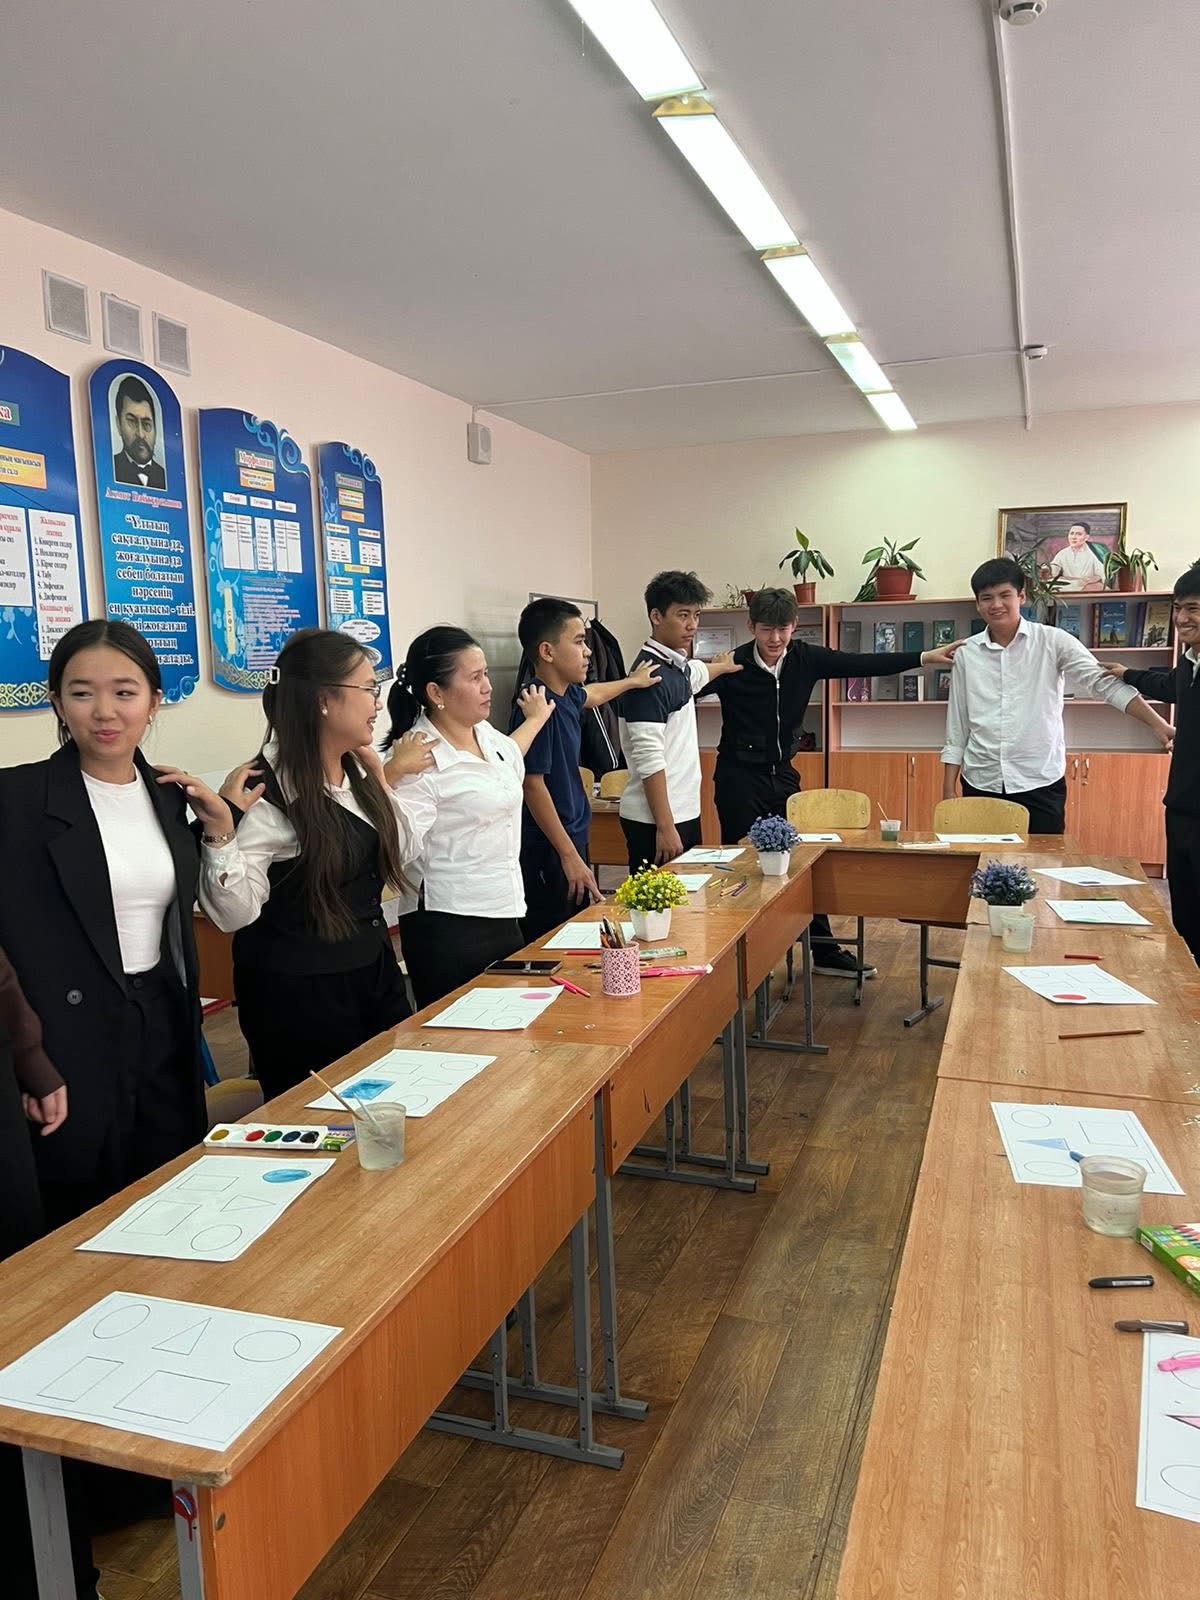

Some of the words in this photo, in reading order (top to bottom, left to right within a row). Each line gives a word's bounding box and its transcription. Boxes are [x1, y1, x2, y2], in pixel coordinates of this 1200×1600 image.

[0, 406, 12, 421] ка
[111, 532, 170, 550] сақталуына
[116, 551, 170, 566] жоғалуына
[170, 555, 183, 568] да
[116, 566, 144, 580] себеп
[144, 567, 184, 583] болатын
[131, 585, 174, 601] нәрсенің
[122, 603, 170, 617] қуаттысы
[143, 621, 187, 632] жоғалған
[156, 654, 194, 666] ғалады.
